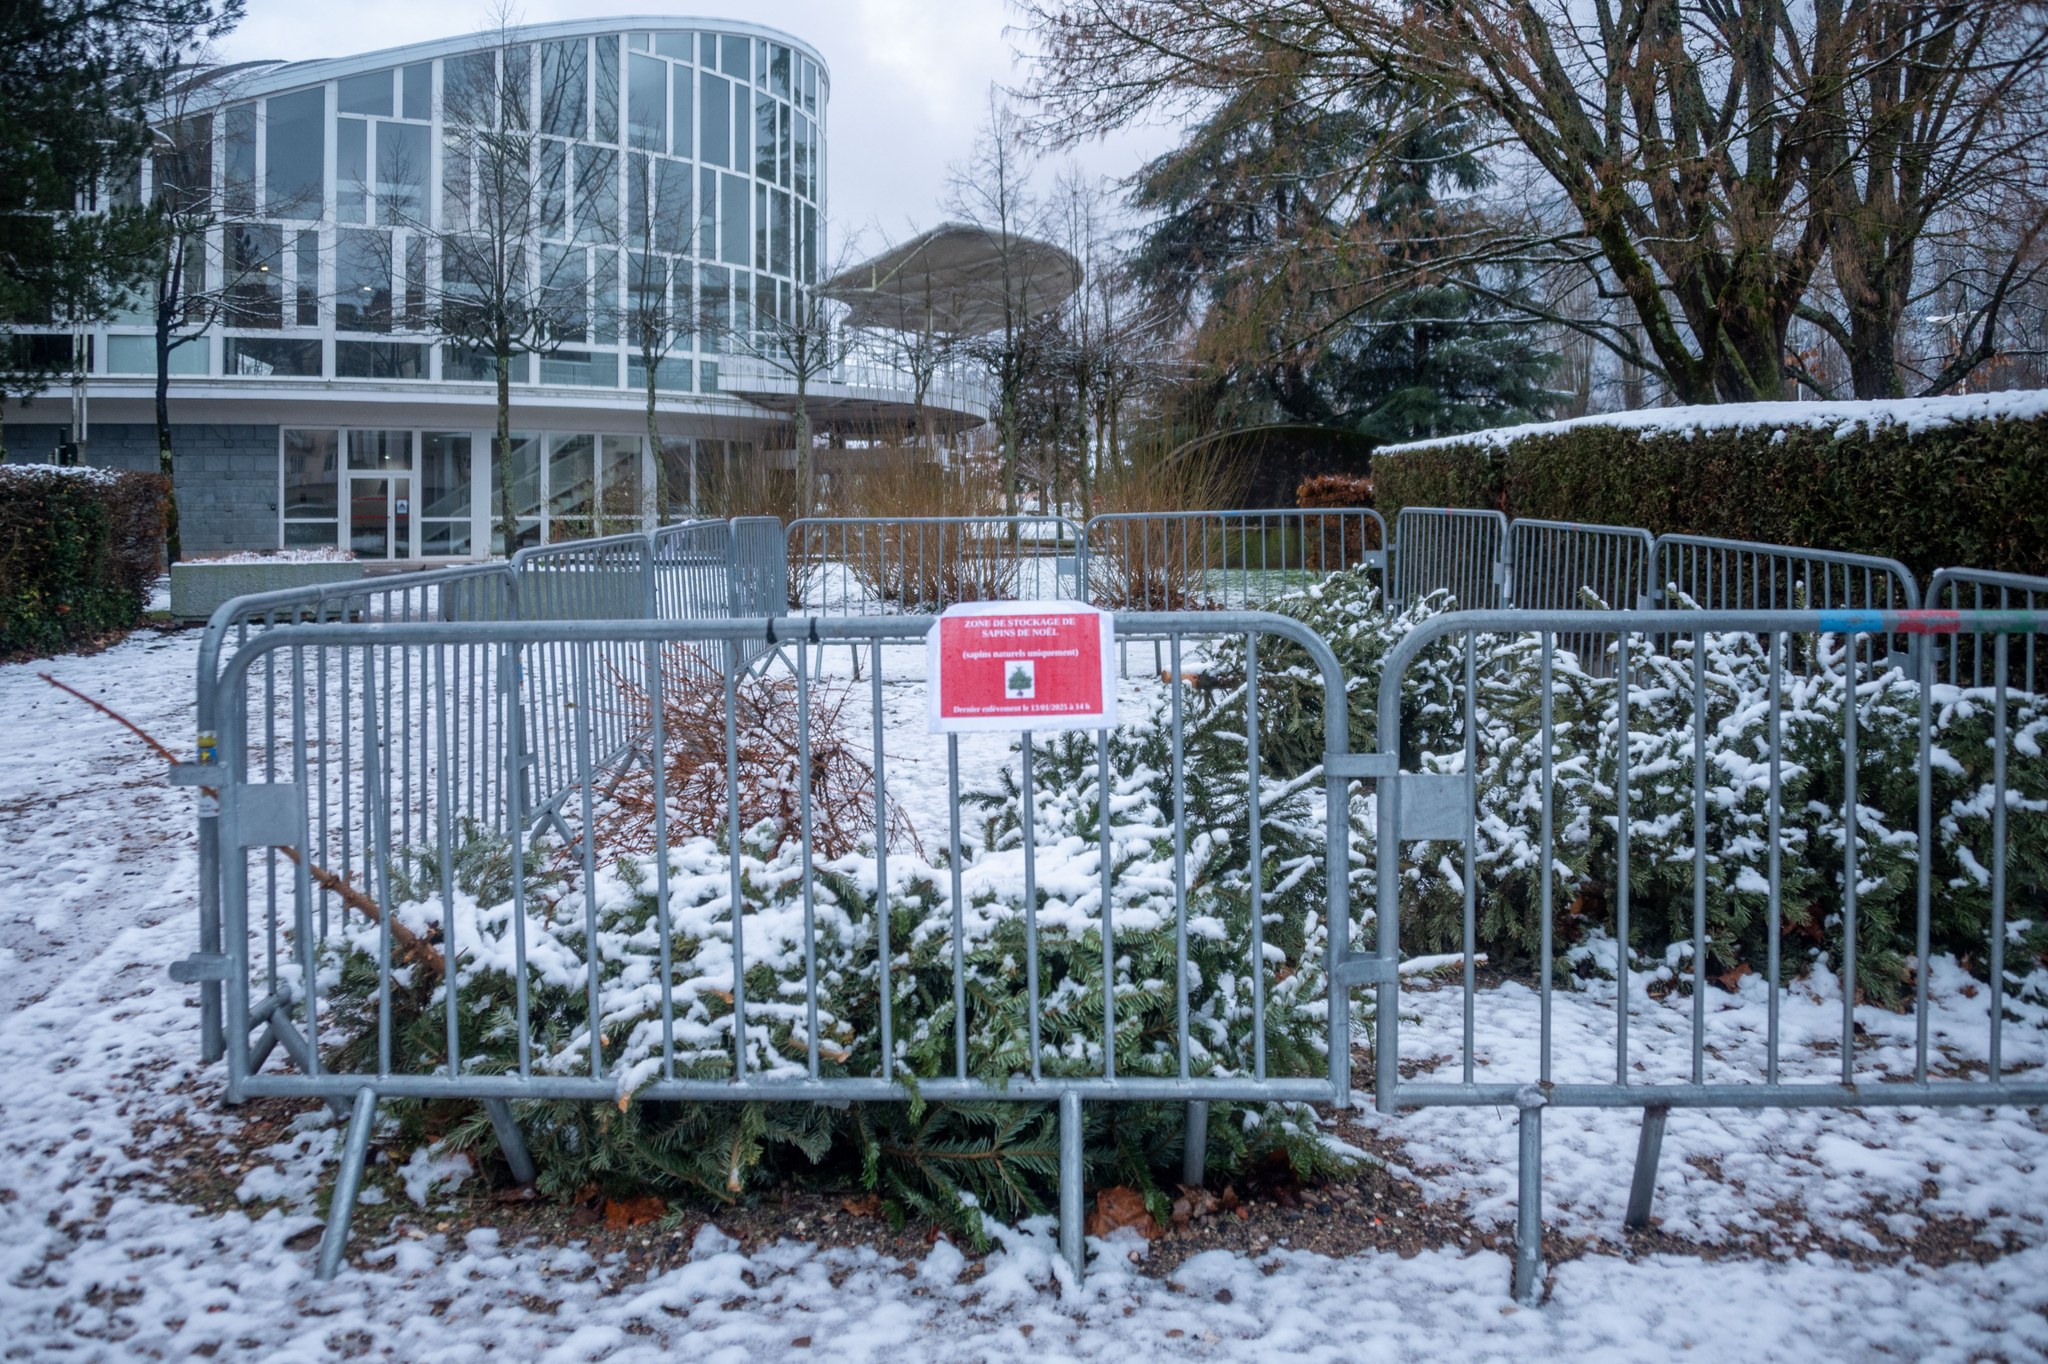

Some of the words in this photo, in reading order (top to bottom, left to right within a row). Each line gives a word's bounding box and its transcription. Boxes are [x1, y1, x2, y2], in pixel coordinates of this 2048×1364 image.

[964, 619, 991, 628] ZONE
[993, 618, 1005, 627] DE
[1007, 617, 1060, 627] STOCKAGE
[1062, 617, 1075, 625] DE
[981, 629, 1015, 638] SAPINS
[1017, 629, 1030, 637] DE
[1032, 627, 1058, 637] NOËL
[962, 650, 991, 660] (sapins
[993, 649, 1026, 658] naturels
[1027, 648, 1079, 659] uniquement)
[953, 705, 981, 713] Dernier
[982, 704, 1021, 713] enlèvement
[1022, 704, 1030, 712] le
